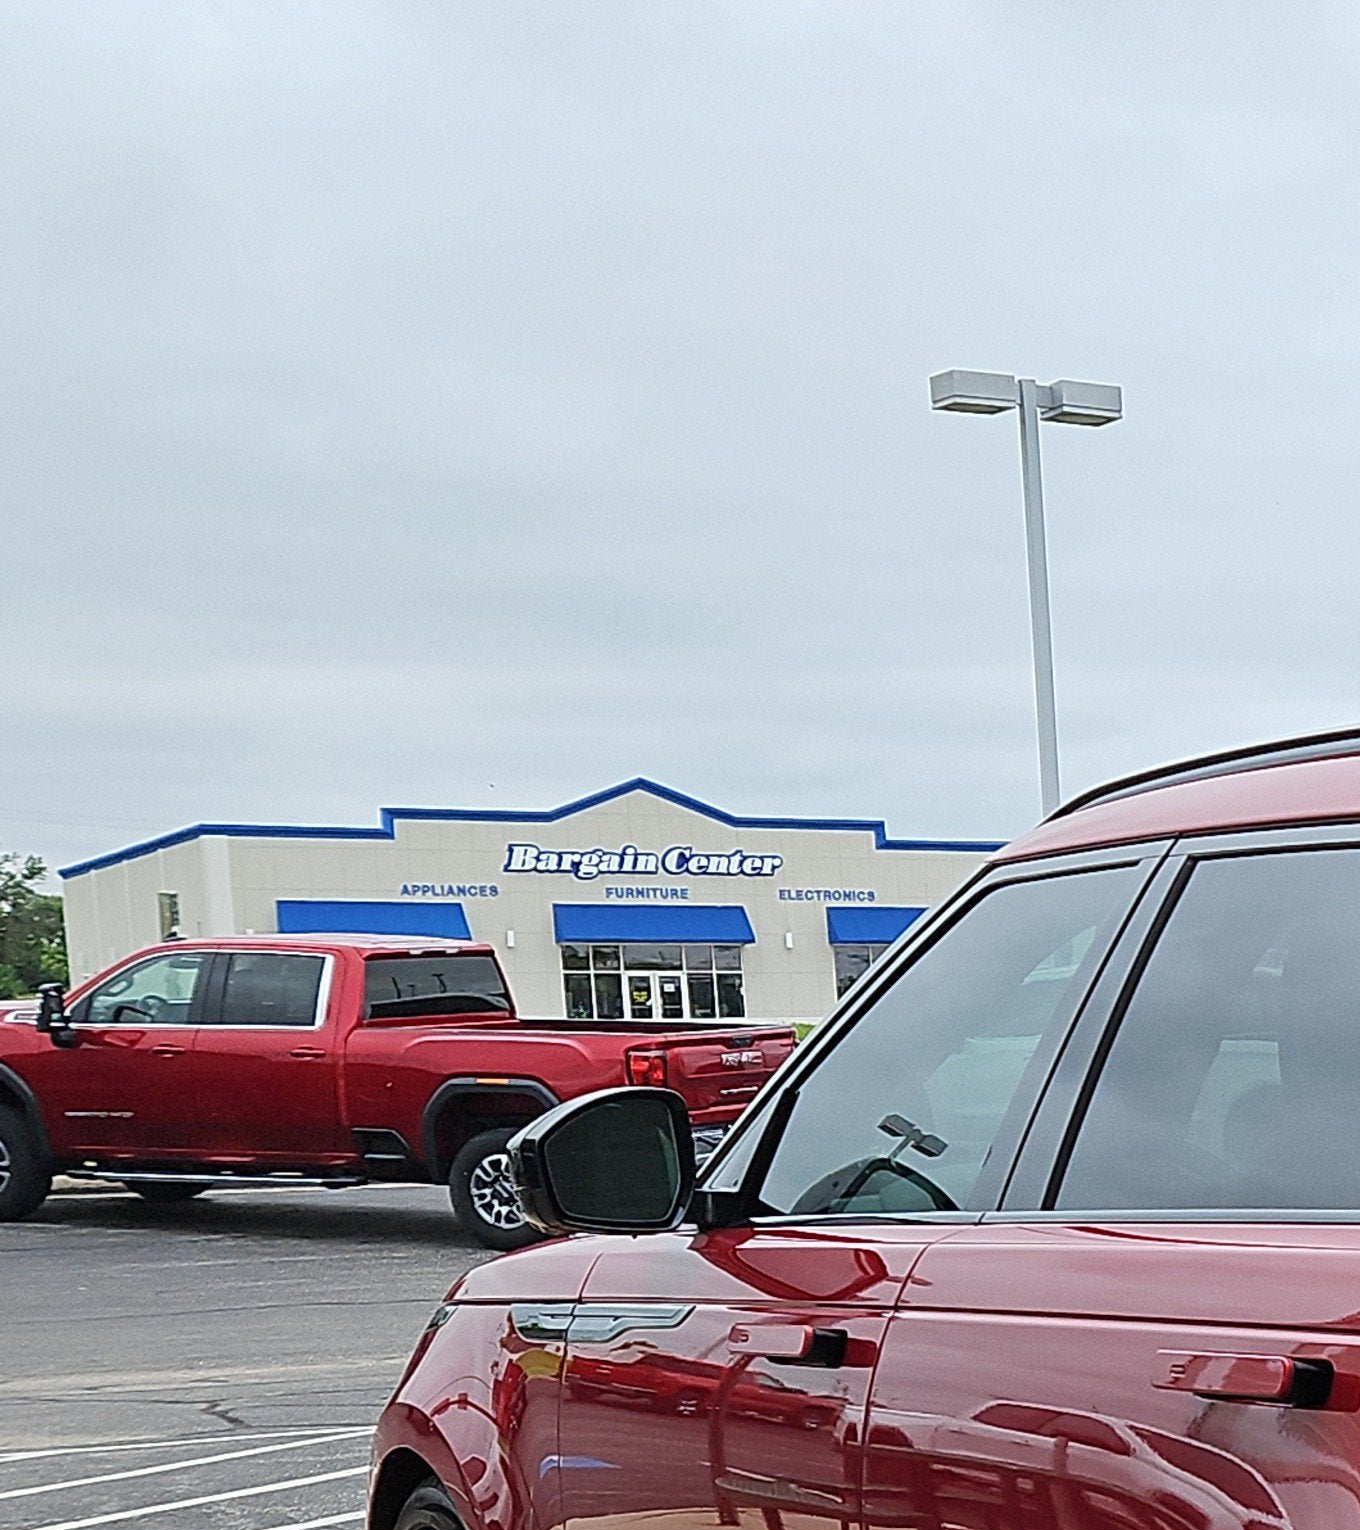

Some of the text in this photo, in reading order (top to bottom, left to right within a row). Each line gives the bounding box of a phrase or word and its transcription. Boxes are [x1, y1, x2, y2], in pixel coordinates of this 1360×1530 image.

[503, 844, 783, 880] Bargain Center
[400, 884, 499, 897] APPLIANCES
[605, 886, 690, 899] FURNITURE
[778, 889, 875, 902] ELECTRONICS
